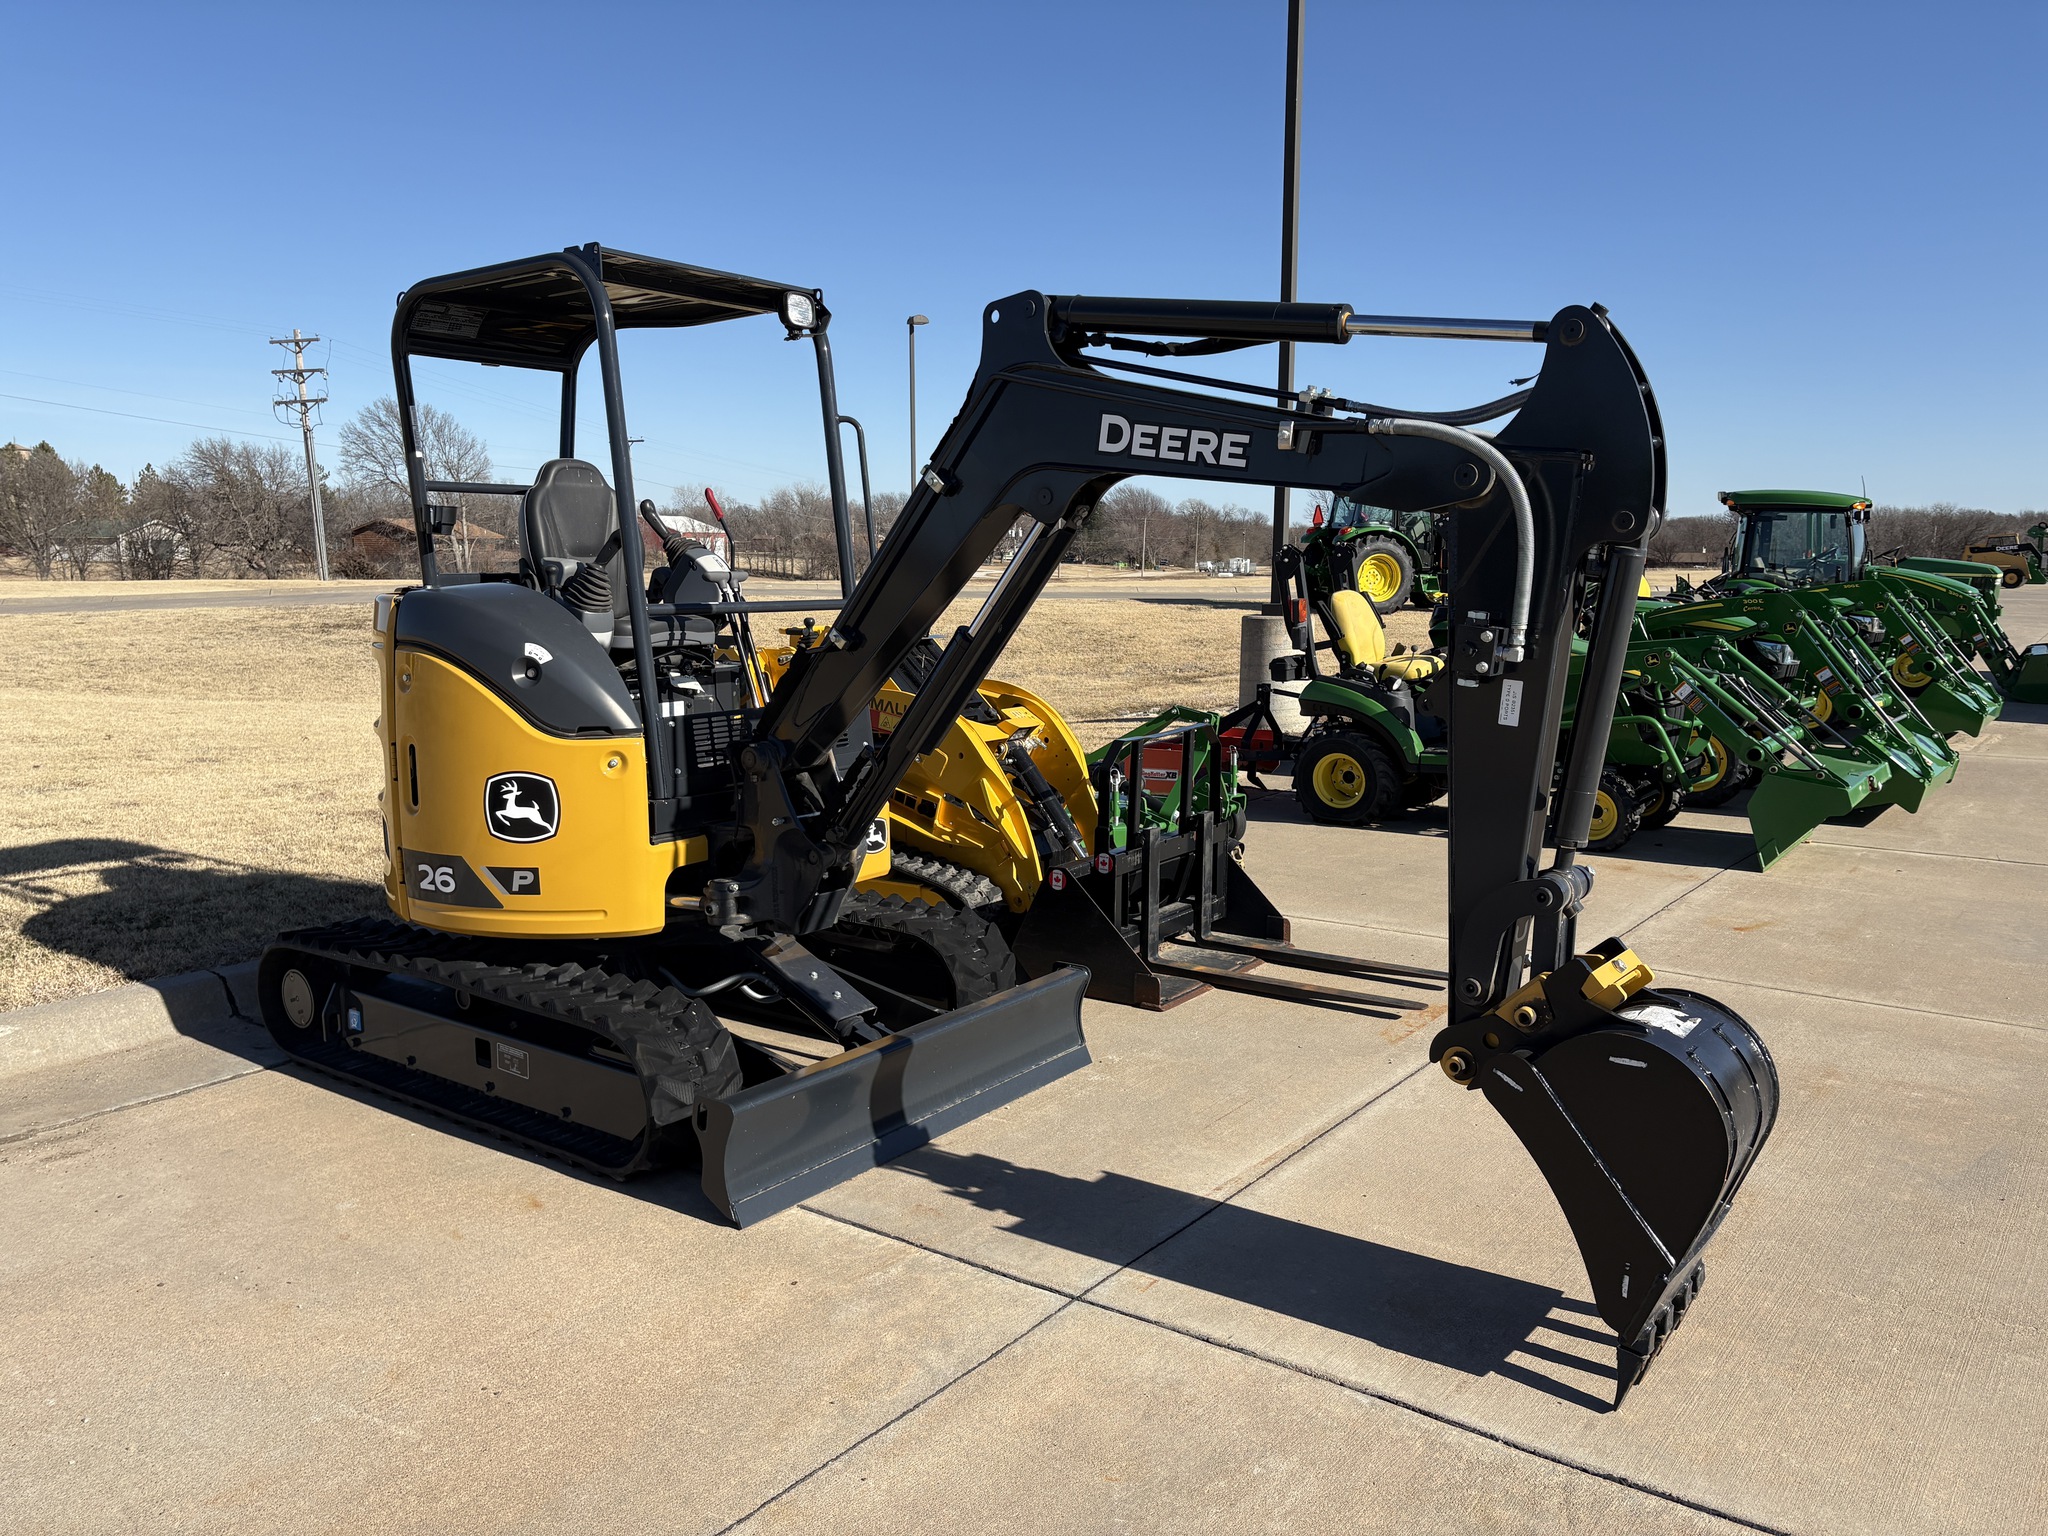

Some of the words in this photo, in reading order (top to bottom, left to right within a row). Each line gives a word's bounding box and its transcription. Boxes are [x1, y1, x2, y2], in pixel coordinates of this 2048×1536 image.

[1098, 413, 1250, 468] DEERE
[1166, 771, 1177, 779] XB
[418, 864, 456, 893] 26
[512, 870, 534, 892] P
